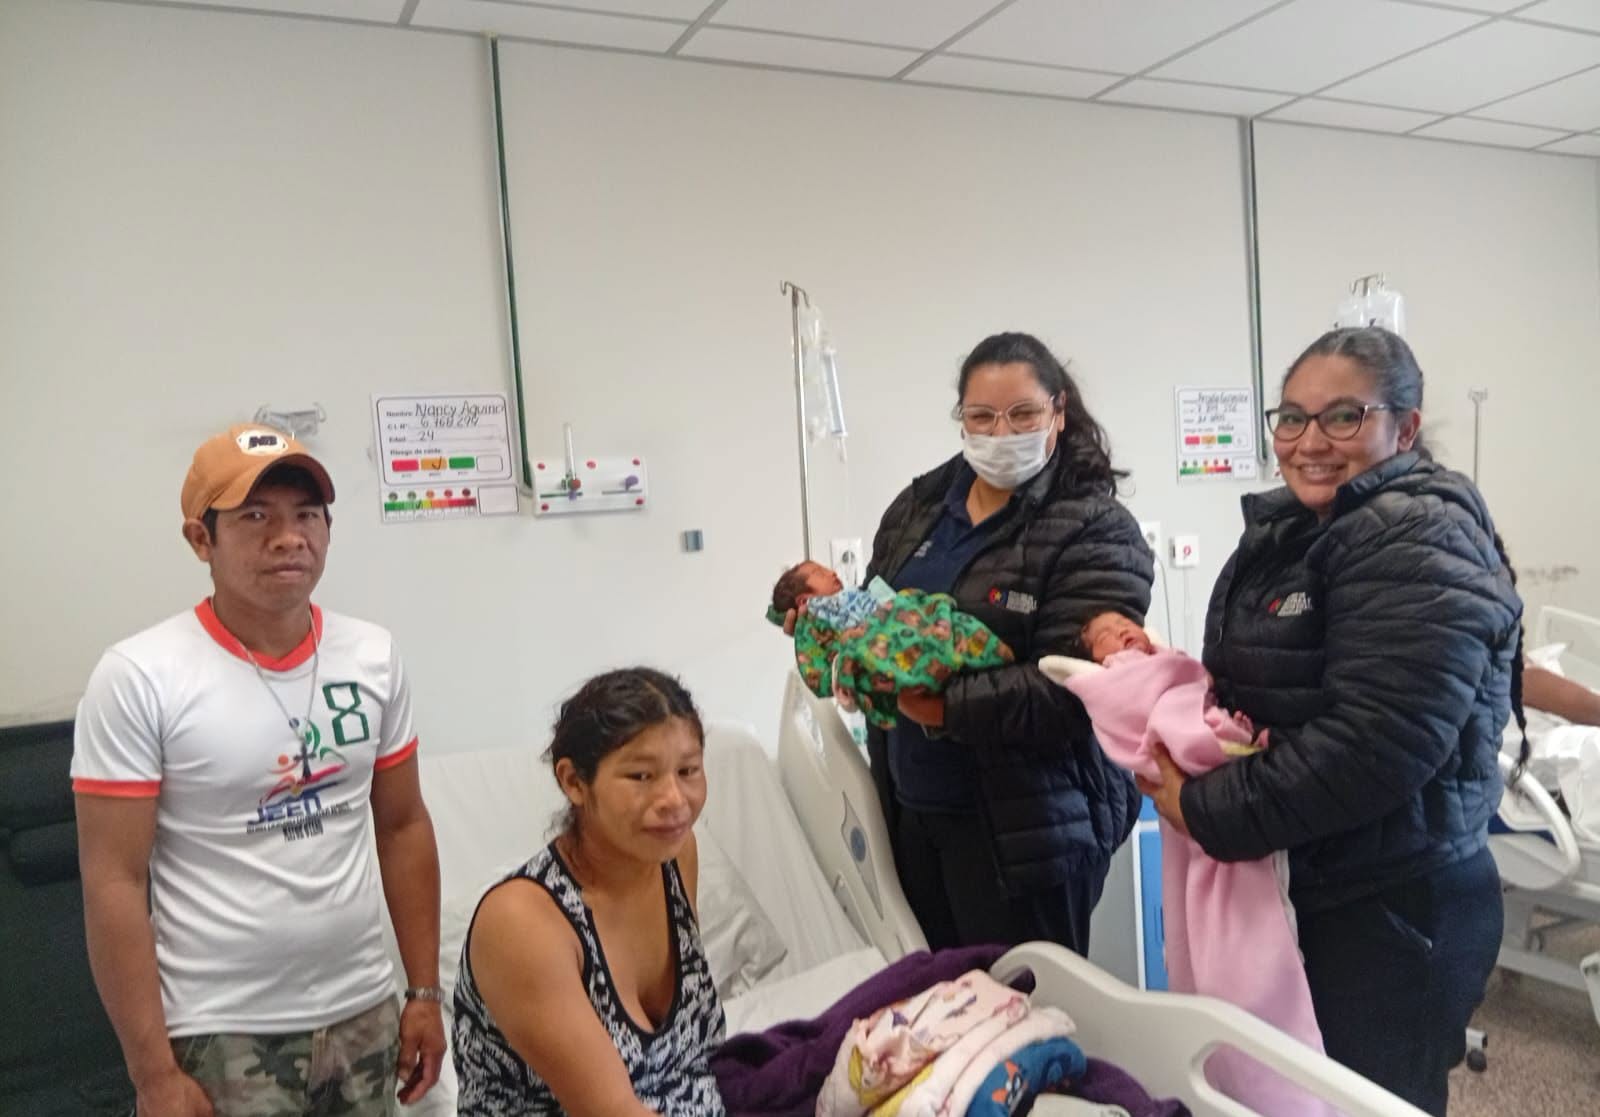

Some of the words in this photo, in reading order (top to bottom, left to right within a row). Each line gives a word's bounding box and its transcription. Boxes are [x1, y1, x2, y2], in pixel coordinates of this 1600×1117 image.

[415, 403, 456, 420] Nancy
[419, 430, 434, 441] 24
[322, 681, 370, 746] 8
